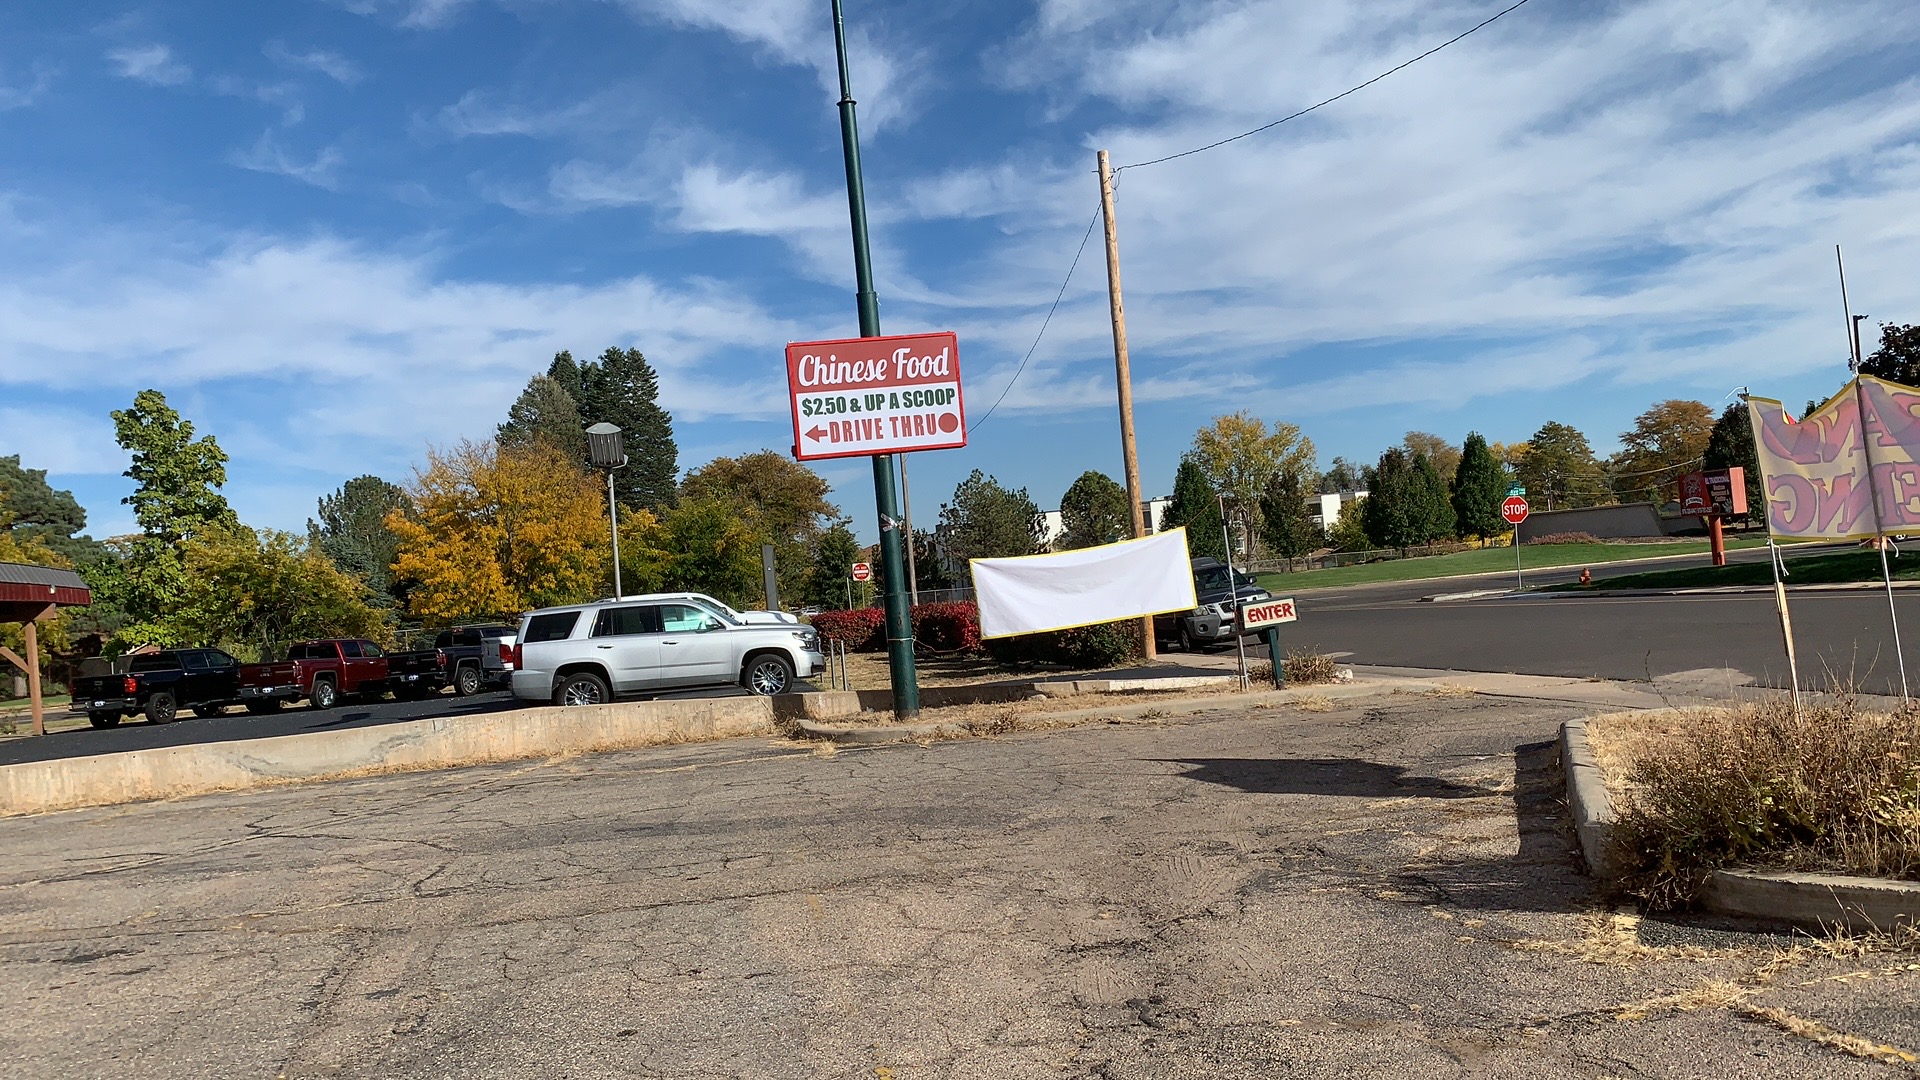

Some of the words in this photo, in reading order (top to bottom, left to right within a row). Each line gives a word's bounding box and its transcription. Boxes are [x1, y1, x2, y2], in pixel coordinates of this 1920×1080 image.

[798, 354, 888, 387] Chinese
[892, 346, 949, 380] Food
[801, 396, 847, 417] $2.50
[850, 398, 862, 412] &
[864, 392, 885, 411] UP
[889, 392, 900, 409] A
[902, 388, 955, 408] SCOOP
[829, 418, 884, 443] DRIVE
[889, 413, 937, 438] THRU
[1504, 504, 1526, 515] STOP
[1247, 603, 1293, 622] ENTER
